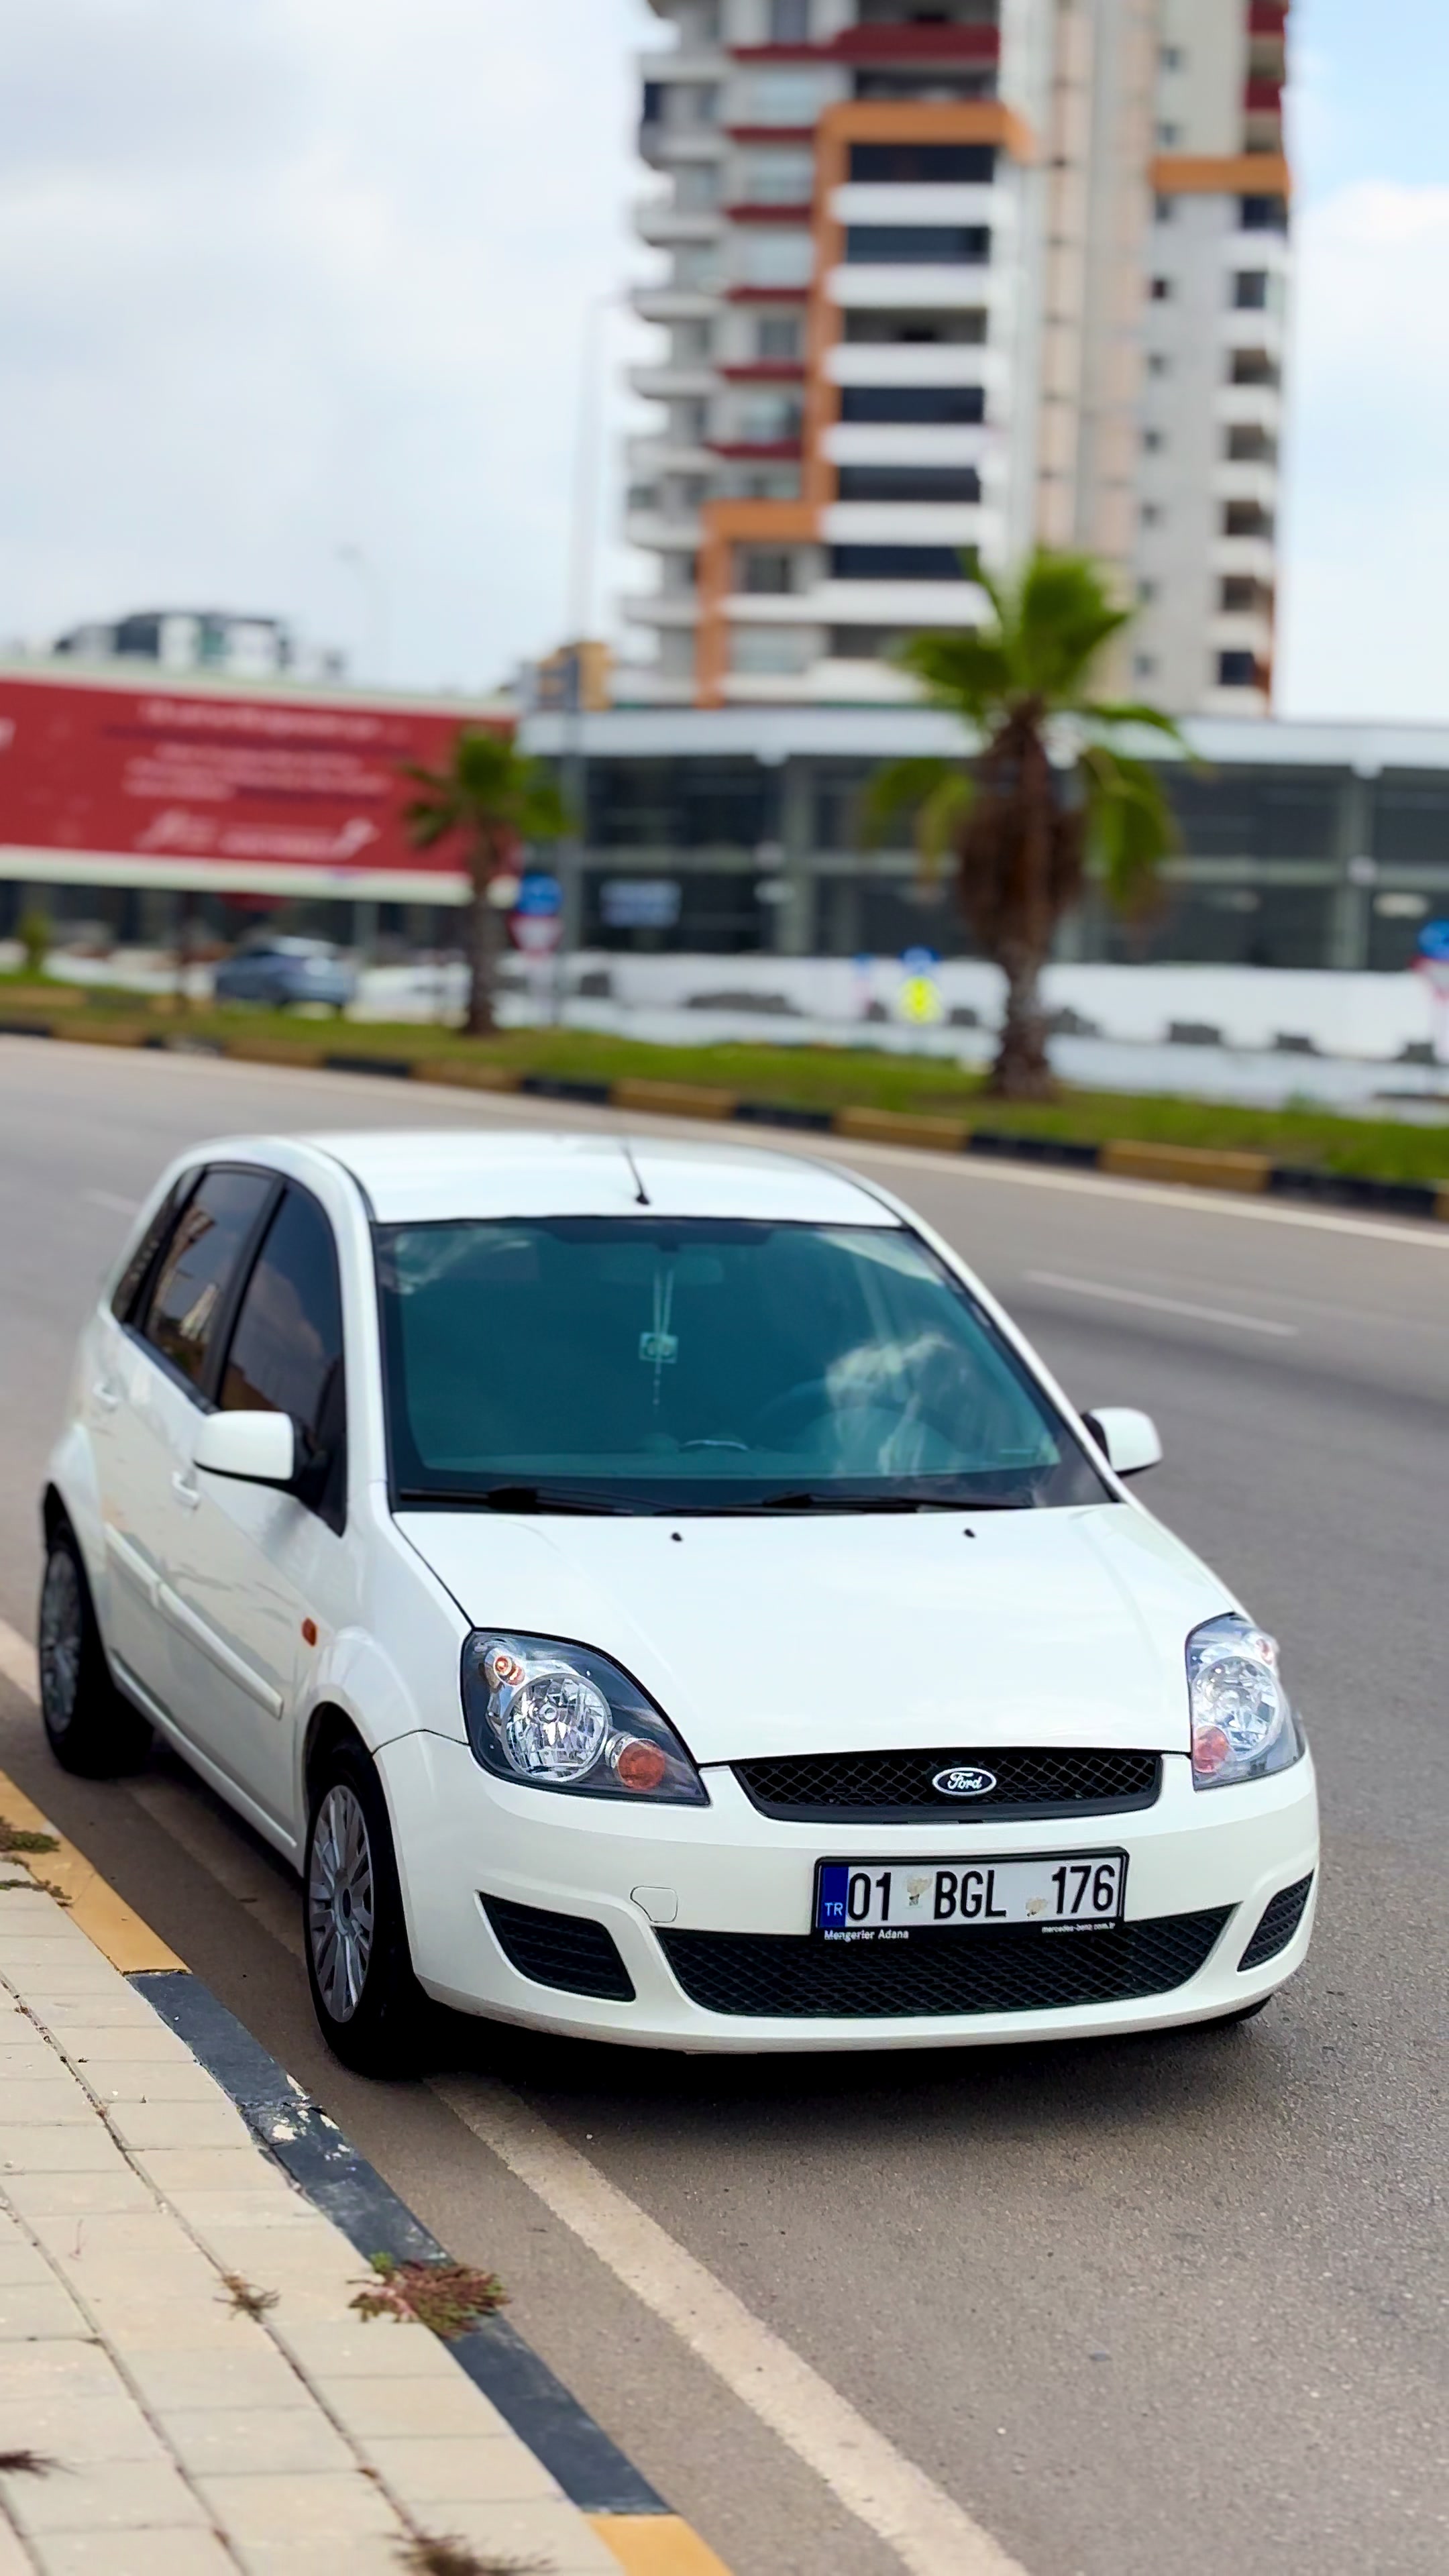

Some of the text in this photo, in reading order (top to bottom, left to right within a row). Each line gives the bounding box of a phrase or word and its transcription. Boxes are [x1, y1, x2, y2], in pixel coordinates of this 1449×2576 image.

[947, 1772, 982, 1789] Ford
[848, 1864, 1116, 1921] 01 BGL 176
[824, 1902, 843, 1916] TR
[878, 1929, 909, 1939] Adana
